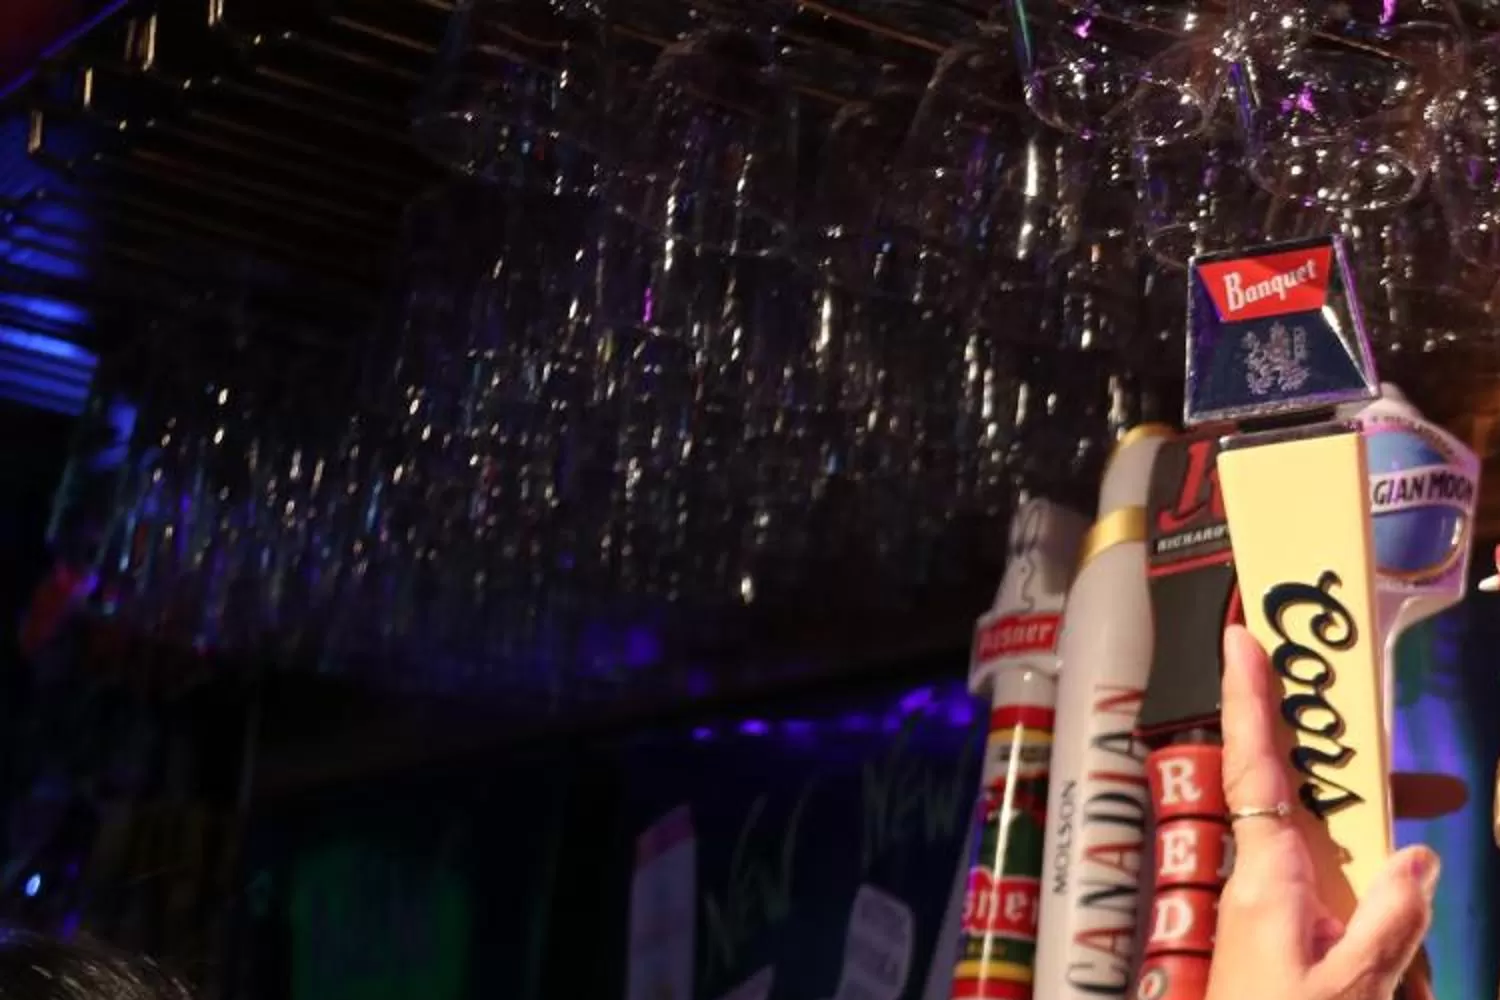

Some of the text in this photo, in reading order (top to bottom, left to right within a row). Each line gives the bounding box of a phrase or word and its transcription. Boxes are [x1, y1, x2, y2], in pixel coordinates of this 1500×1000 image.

[1222, 259, 1316, 312] Banquet
[1373, 473, 1425, 505] GIAN
[1052, 779, 1077, 895] MOLSON
[1066, 683, 1148, 995] CANADIAN
